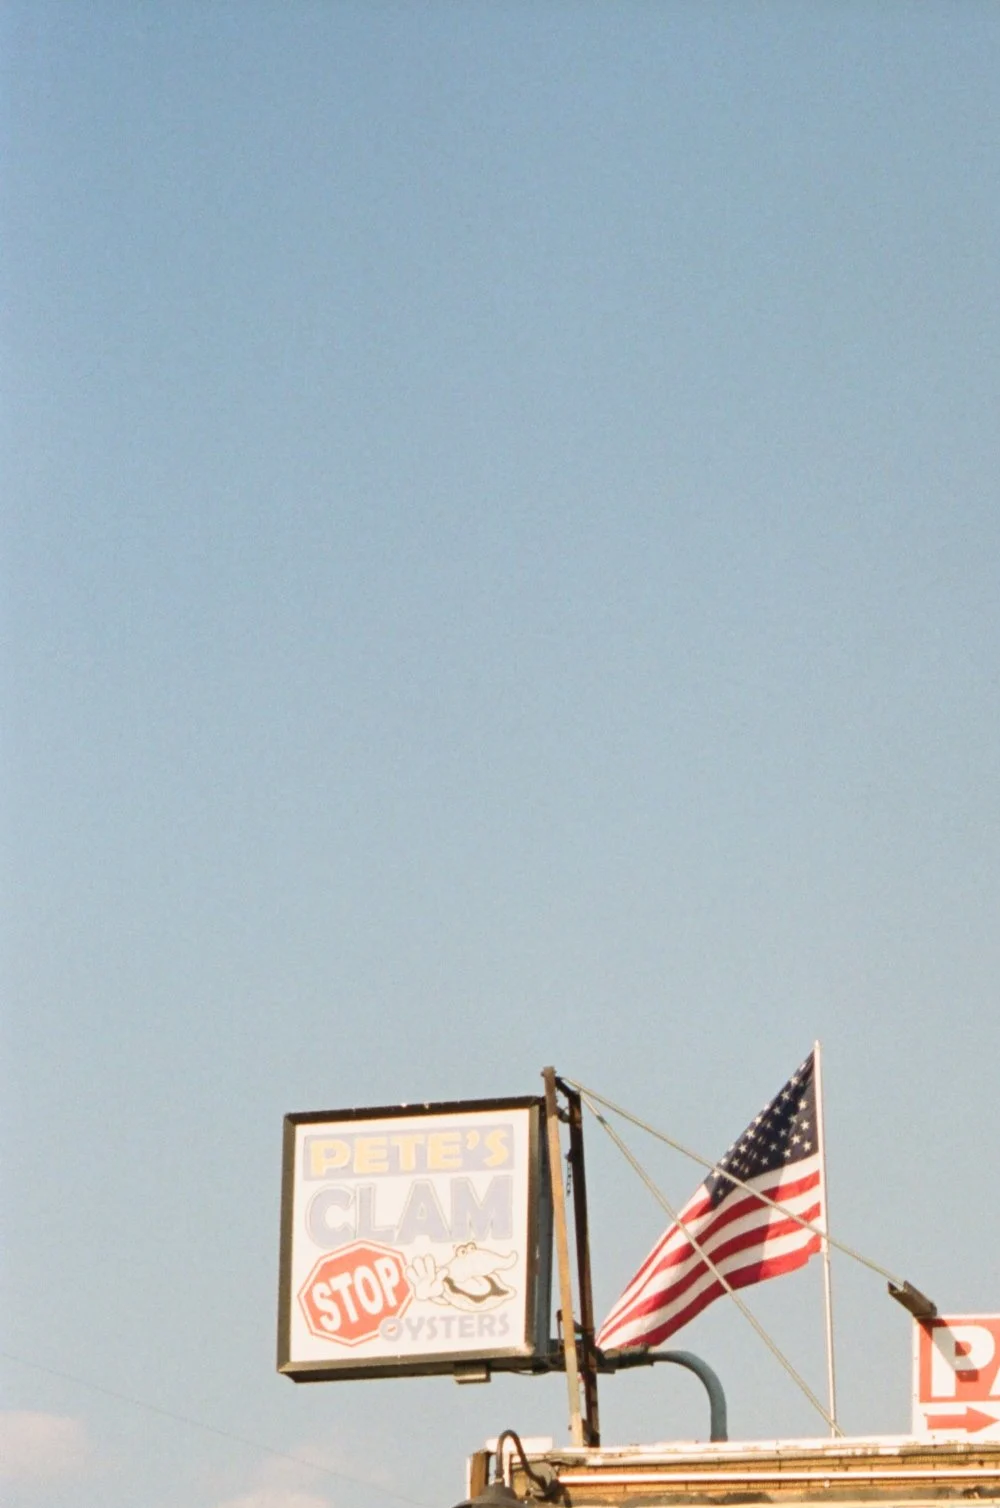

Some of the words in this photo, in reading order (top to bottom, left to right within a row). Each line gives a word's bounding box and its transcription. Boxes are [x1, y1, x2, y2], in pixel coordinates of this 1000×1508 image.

[309, 1129, 509, 1175] PETE'S
[304, 1174, 515, 1247] CLAM
[315, 1256, 400, 1332] STOP
[378, 1311, 510, 1342] OYSTERS
